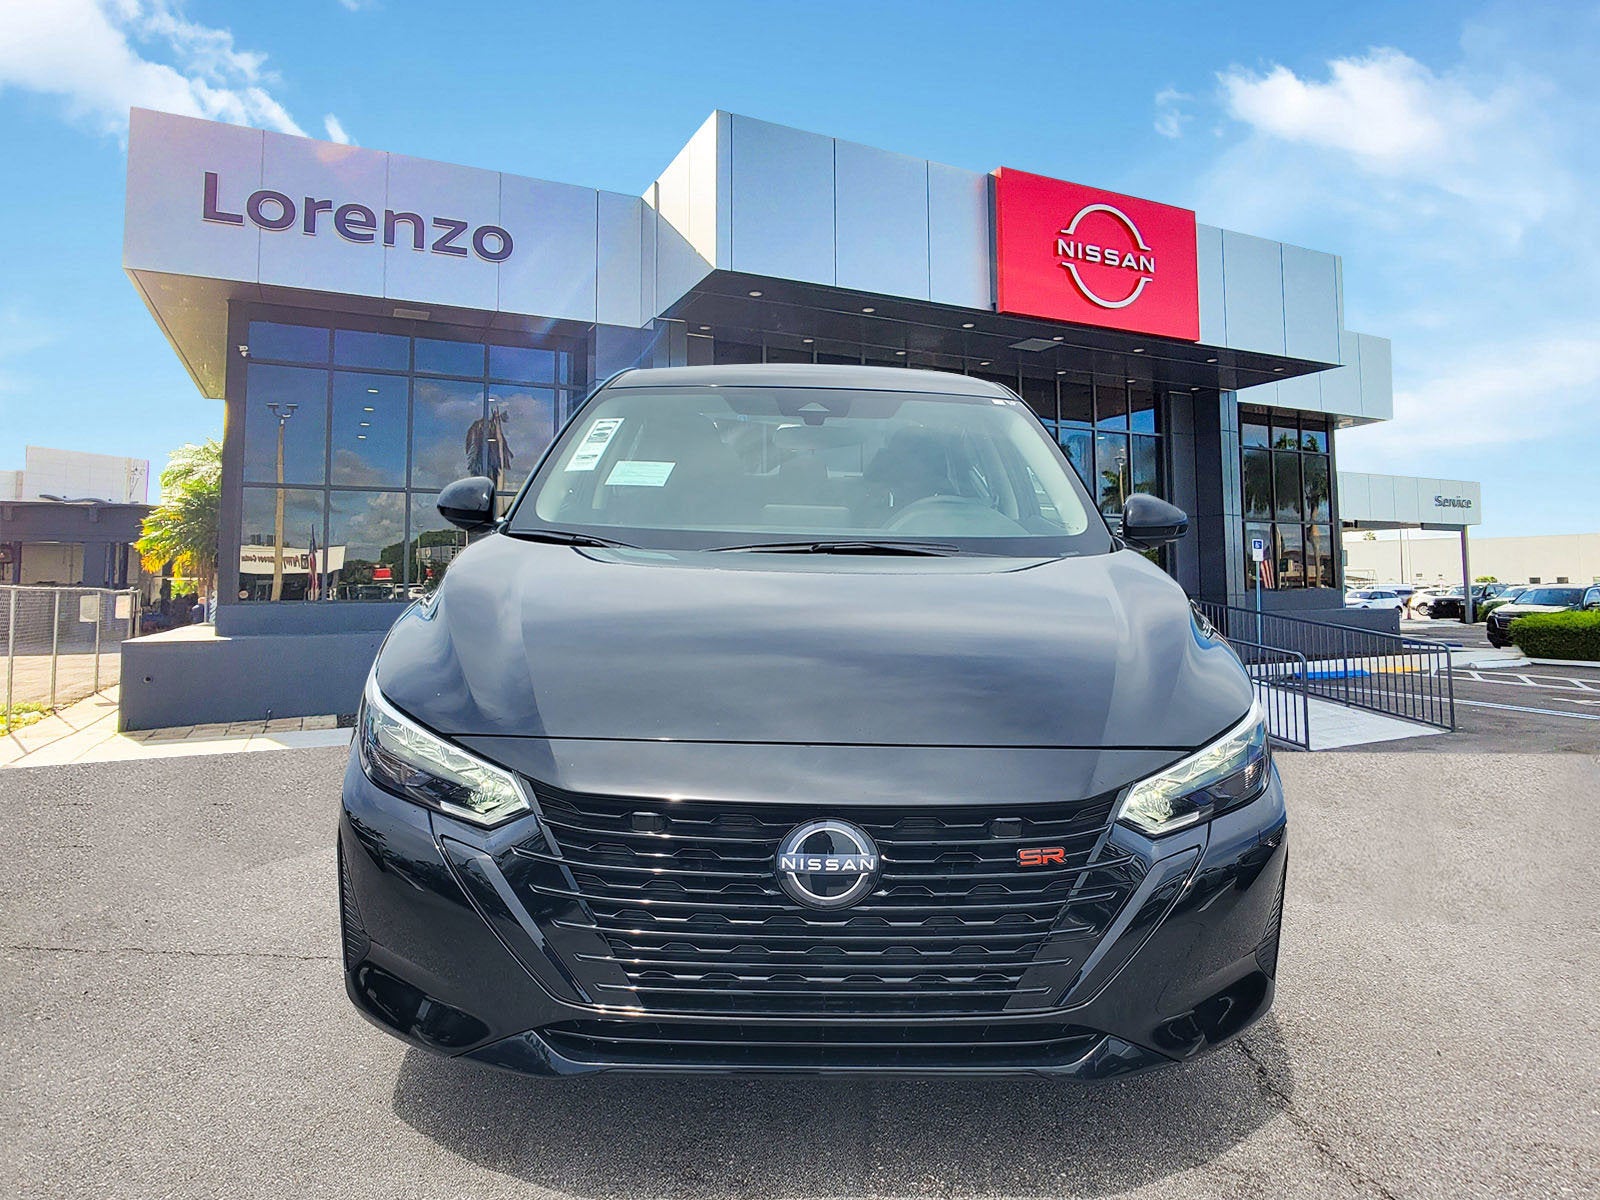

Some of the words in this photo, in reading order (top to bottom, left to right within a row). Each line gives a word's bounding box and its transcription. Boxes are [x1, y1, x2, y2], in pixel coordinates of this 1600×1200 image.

[202, 171, 514, 262] Lorenzo
[1057, 238, 1155, 273] NISSAN
[1434, 495, 1472, 509] Service
[781, 857, 875, 871] NISSAN
[1018, 848, 1066, 866] SR
